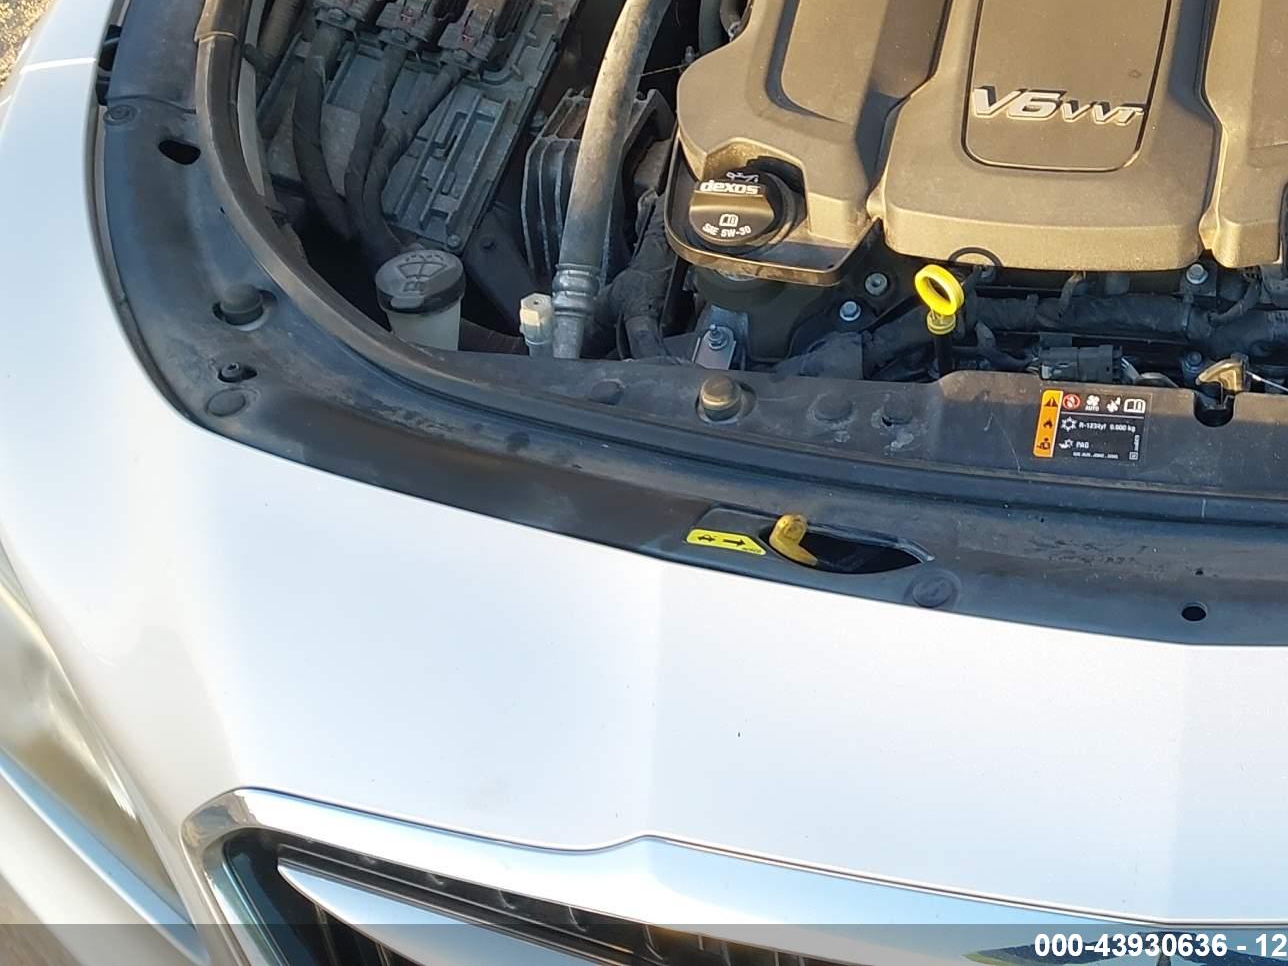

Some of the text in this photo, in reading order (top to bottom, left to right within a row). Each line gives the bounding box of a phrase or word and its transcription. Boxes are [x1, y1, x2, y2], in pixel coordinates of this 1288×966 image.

[700, 179, 759, 194] dexos
[702, 223, 752, 238] SAE 5W-30
